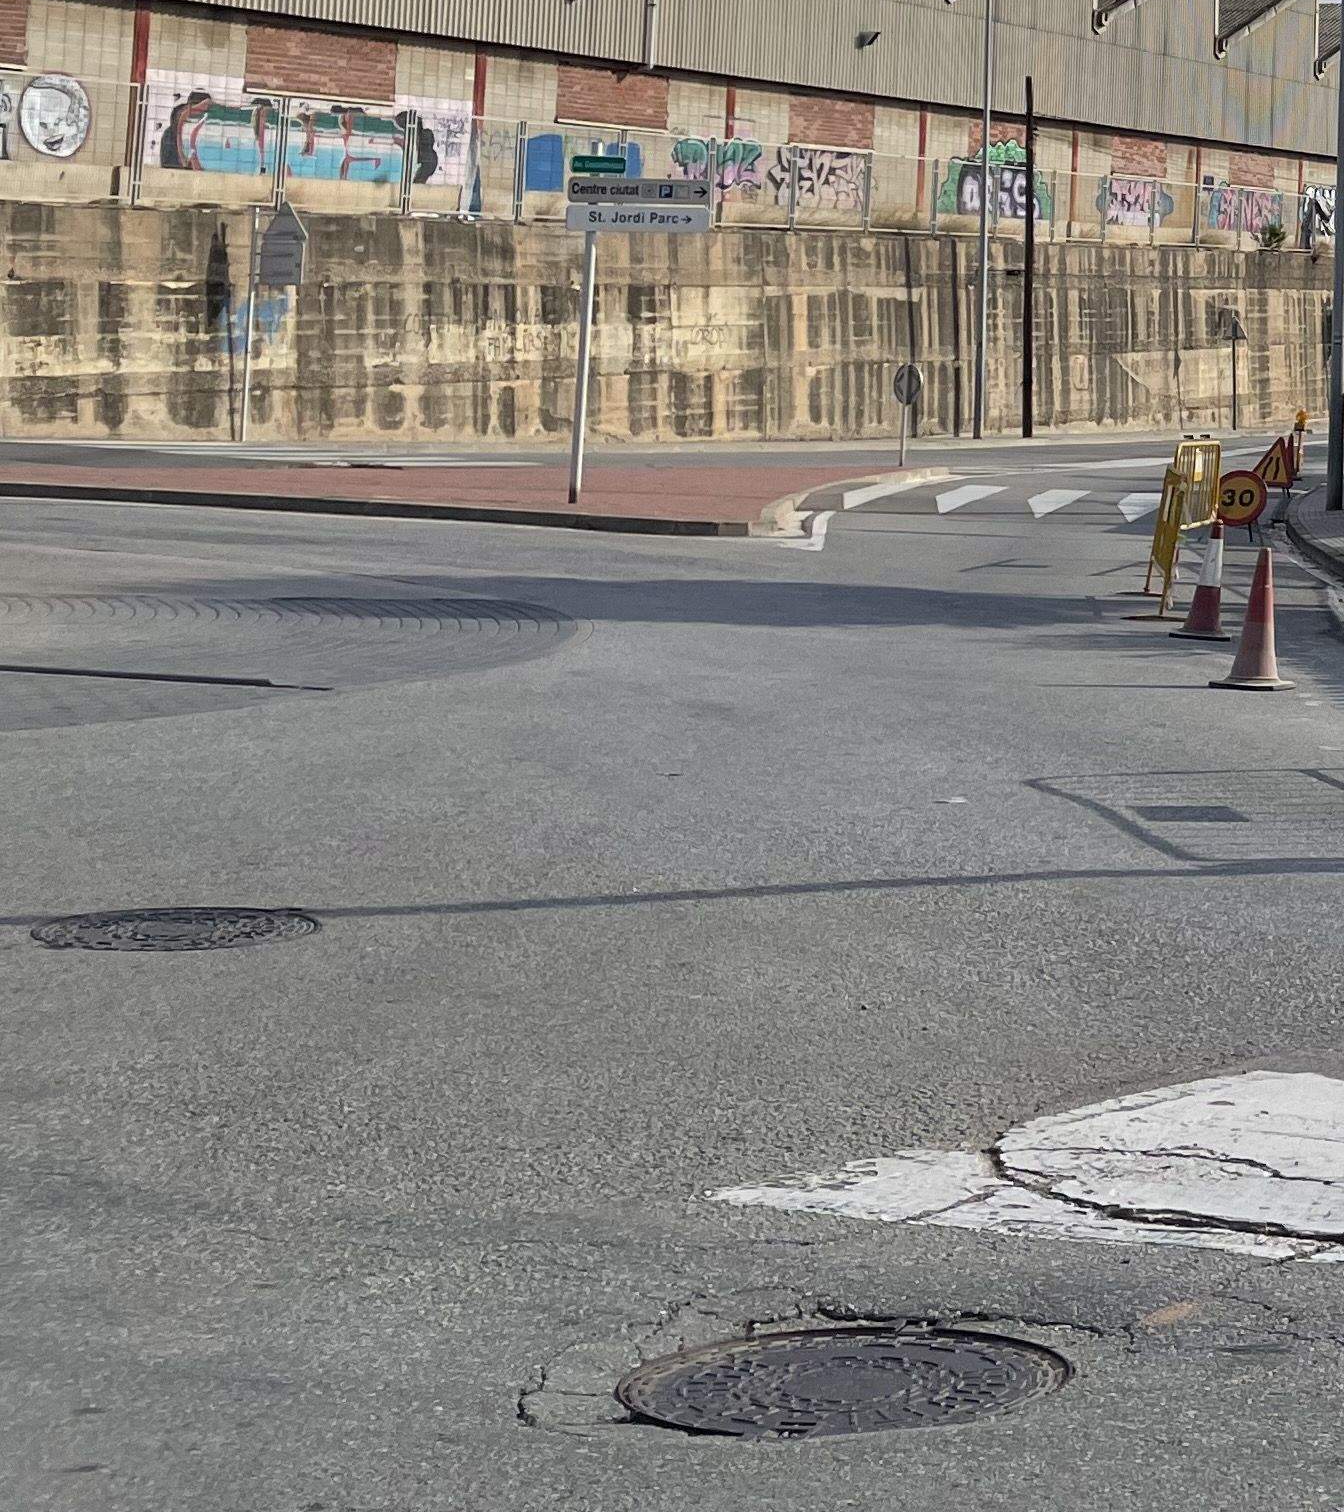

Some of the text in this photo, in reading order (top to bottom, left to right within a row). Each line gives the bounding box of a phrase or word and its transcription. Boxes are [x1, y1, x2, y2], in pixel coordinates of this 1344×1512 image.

[571, 182, 640, 196] Centre ciutat
[588, 211, 680, 225] St. Jordi Parc
[1221, 489, 1255, 507] 30
